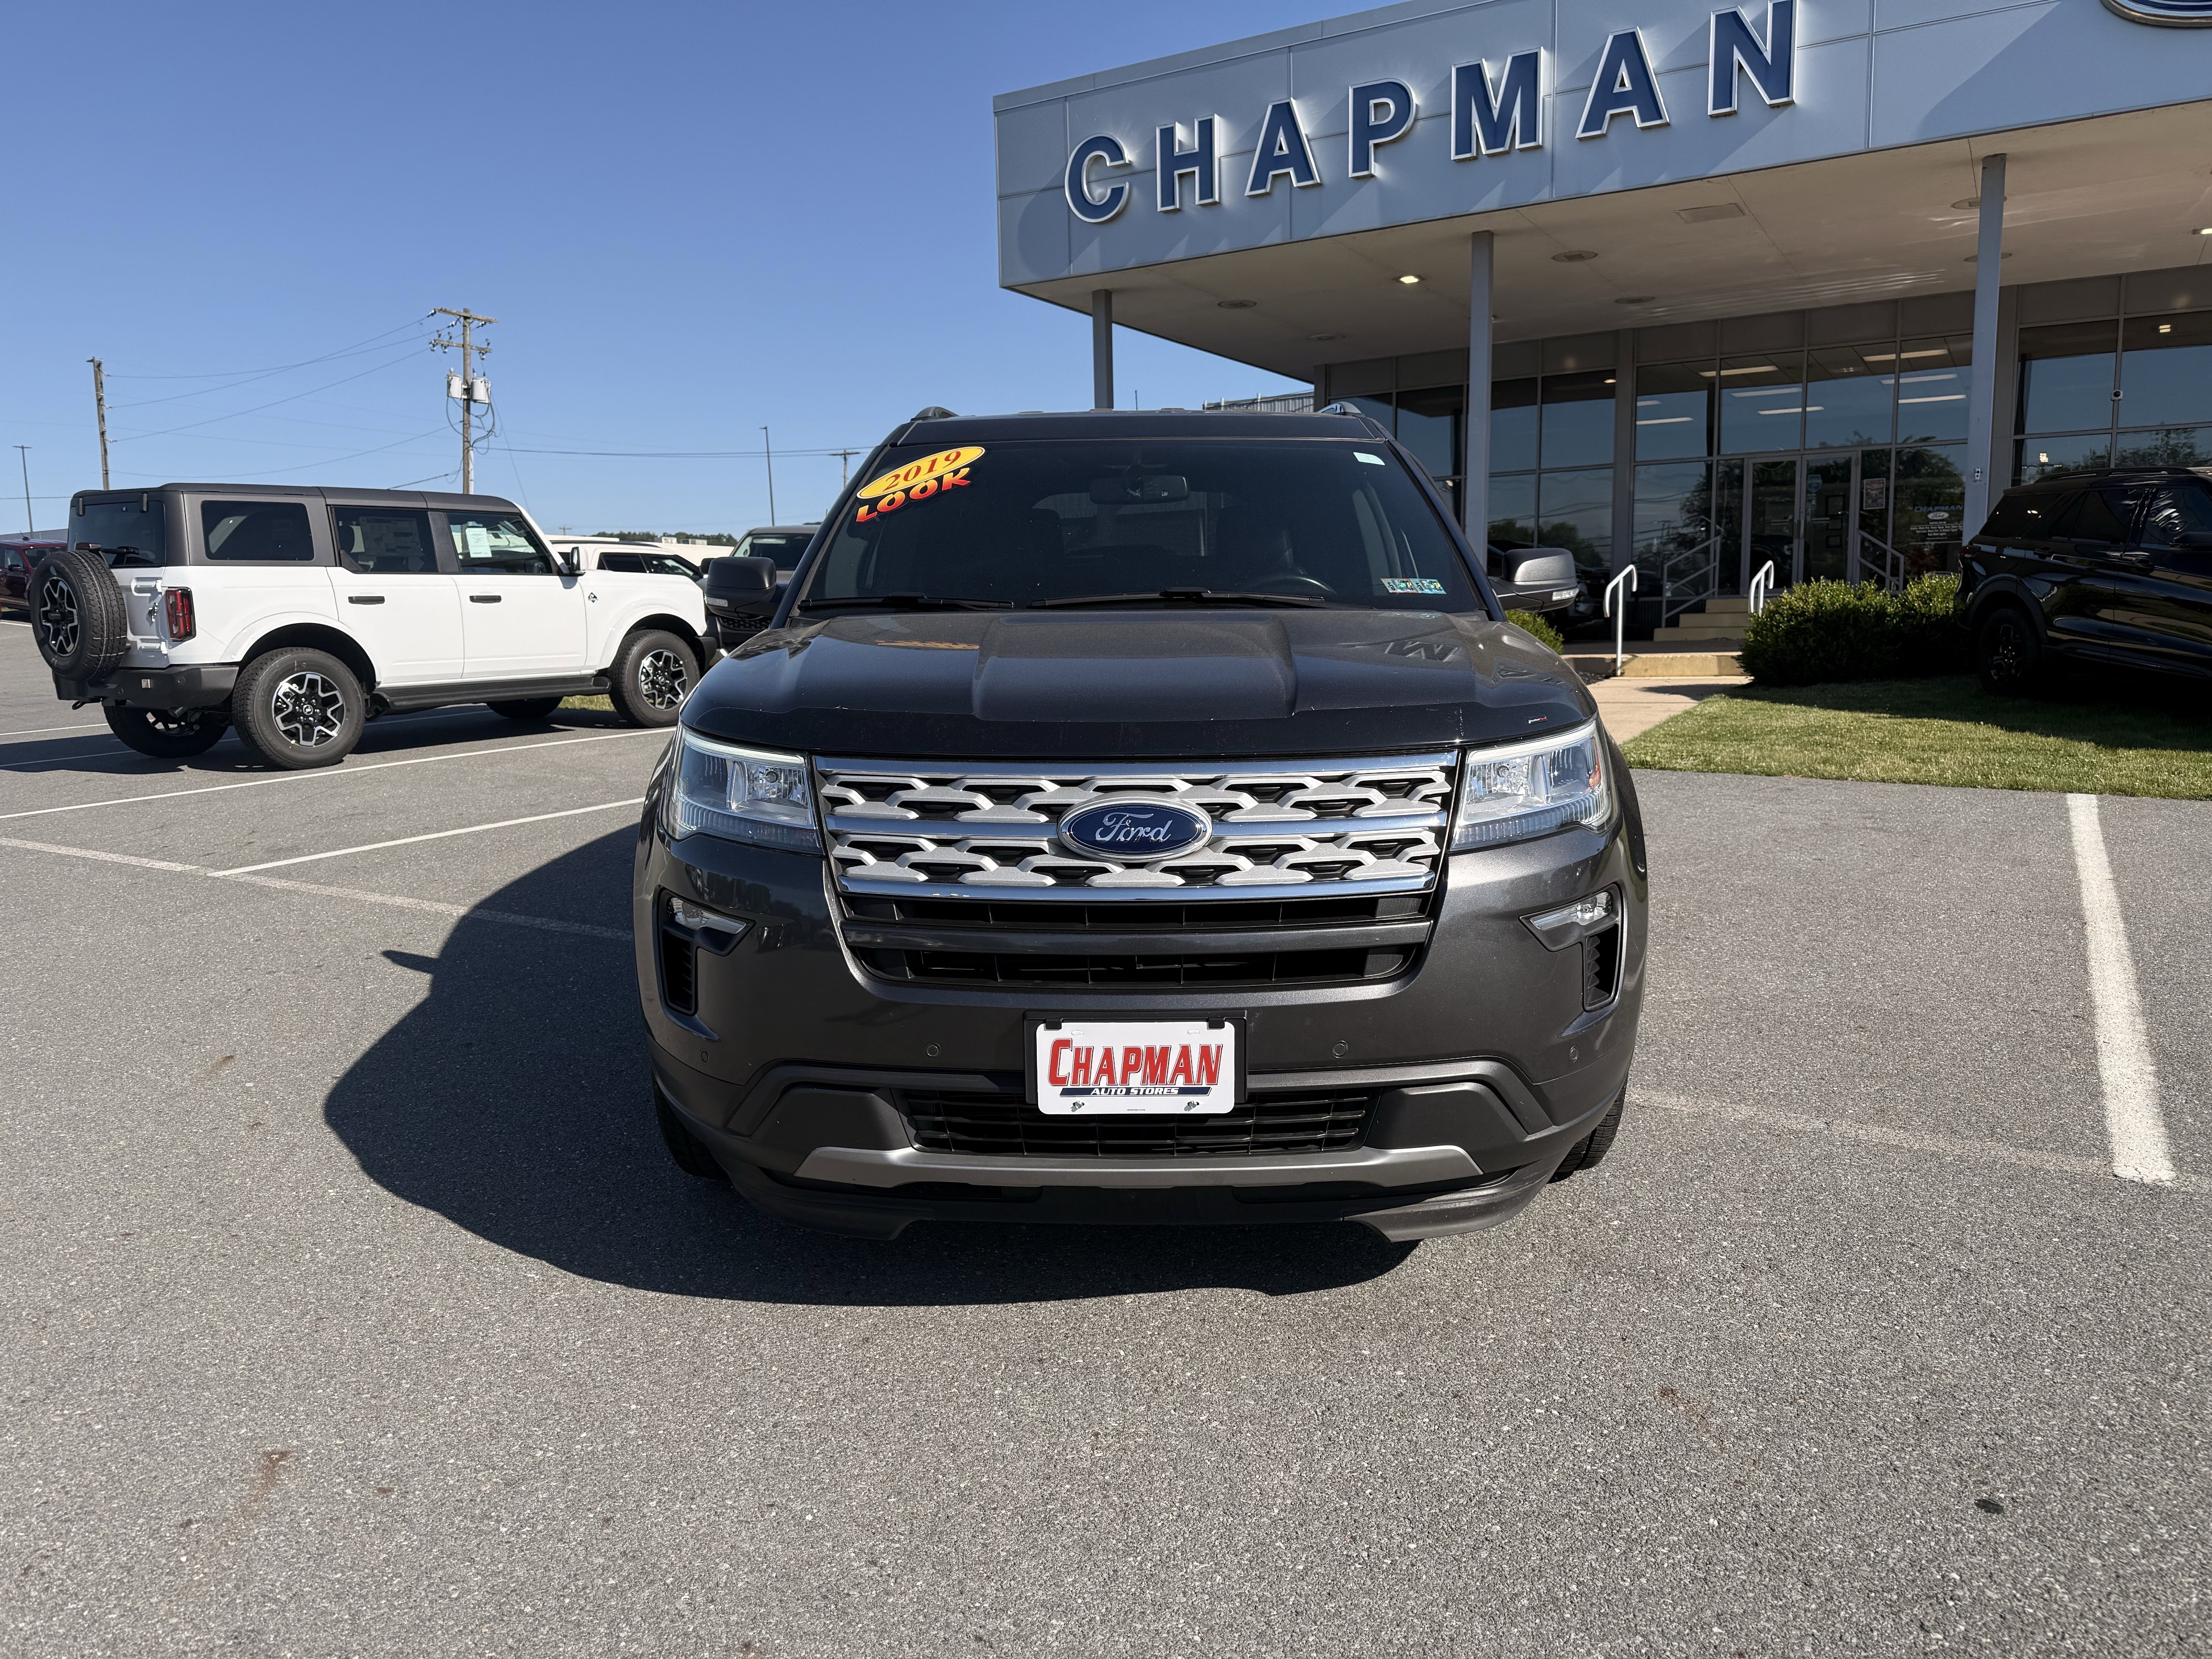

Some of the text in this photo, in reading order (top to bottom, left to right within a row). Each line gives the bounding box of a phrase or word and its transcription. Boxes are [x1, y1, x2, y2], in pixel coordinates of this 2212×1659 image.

[1065, 0, 1797, 223] CHAPMAN
[856, 467, 971, 522] LOOK
[883, 451, 962, 492] 2019
[1095, 812, 1173, 843] Ford
